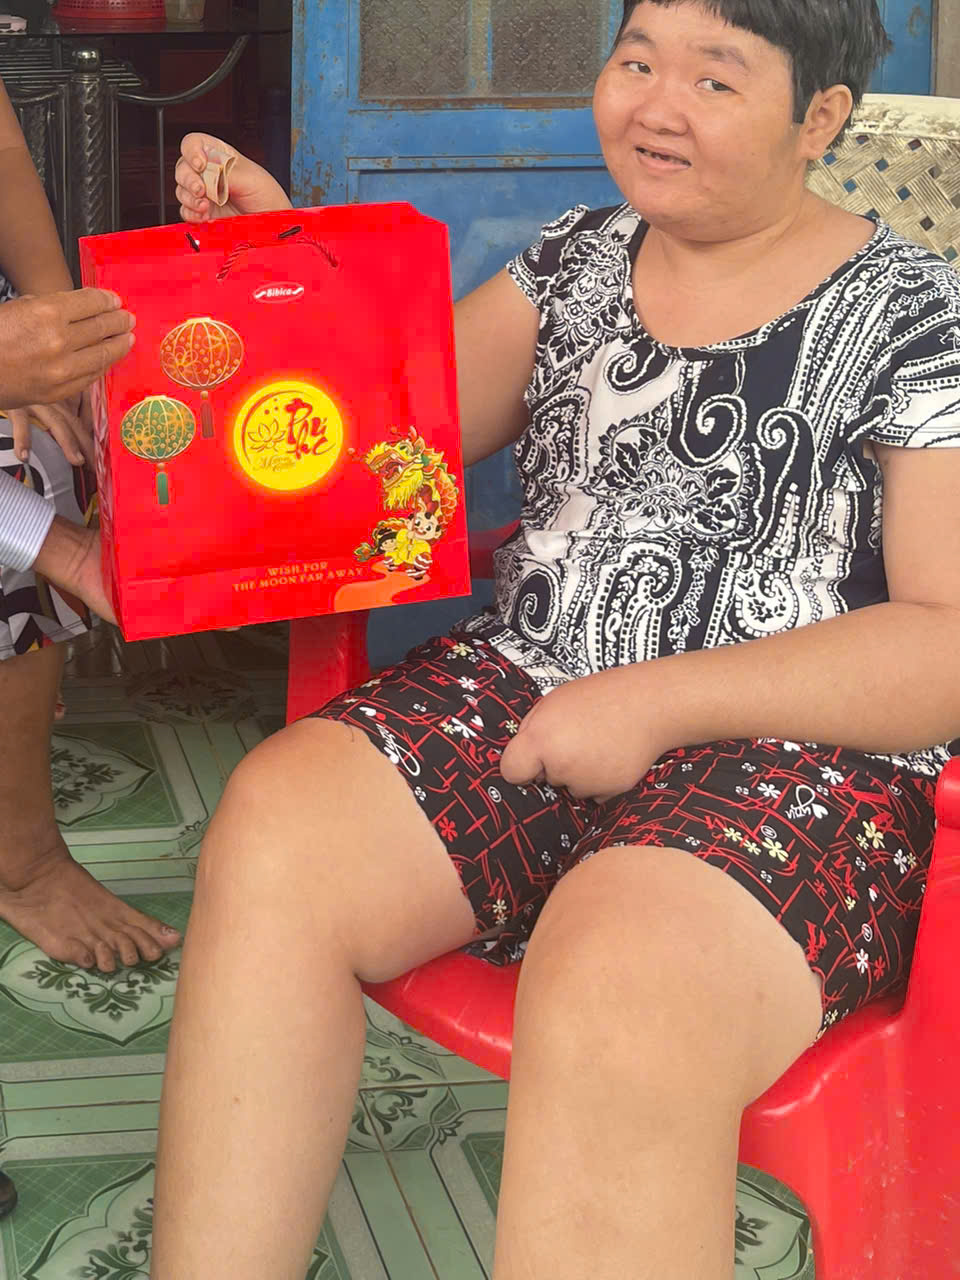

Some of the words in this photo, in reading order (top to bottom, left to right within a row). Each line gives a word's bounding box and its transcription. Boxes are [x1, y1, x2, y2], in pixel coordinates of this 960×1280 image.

[266, 287, 293, 298] Bibica
[268, 564, 300, 576] WISH
[303, 561, 329, 573] FOR
[232, 580, 256, 592] THE
[259, 576, 297, 588] MOON
[299, 572, 324, 583] FAR
[327, 568, 364, 579] AWAY
